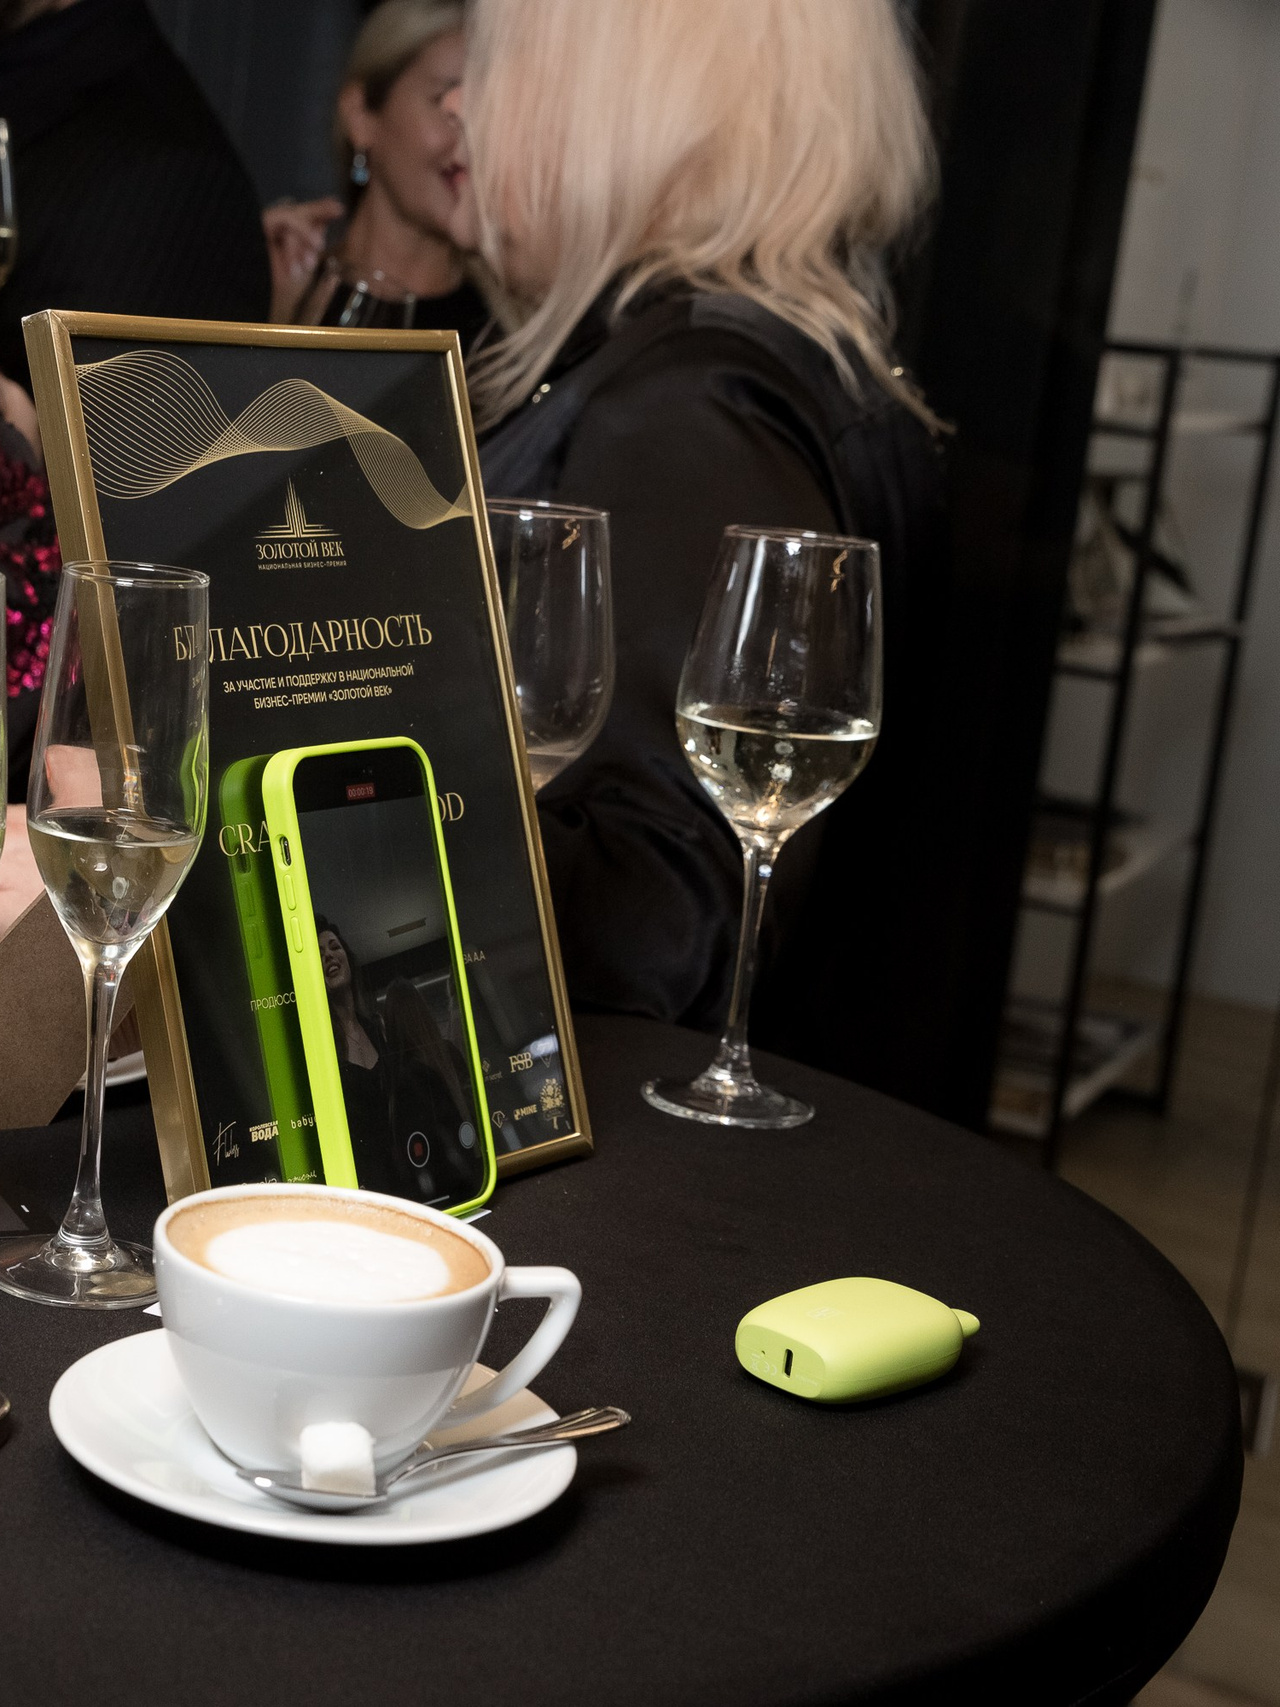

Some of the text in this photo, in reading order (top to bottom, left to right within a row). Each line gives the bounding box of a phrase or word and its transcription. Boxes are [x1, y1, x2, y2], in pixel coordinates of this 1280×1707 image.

[256, 539, 344, 560] ЗОЛОТОЙ ВЕК
[223, 662, 414, 693] ЗА УЧАСТИЕ И ПОДДЕРЖКУ В НАЦИОНАЛЬНОЙ
[253, 684, 393, 710] БИЗНЕС-ПРЕМИИ «ЗОЛОТОЙ ВЕК»
[290, 1115, 316, 1129] baby
[251, 1126, 279, 1142] ВОДА
